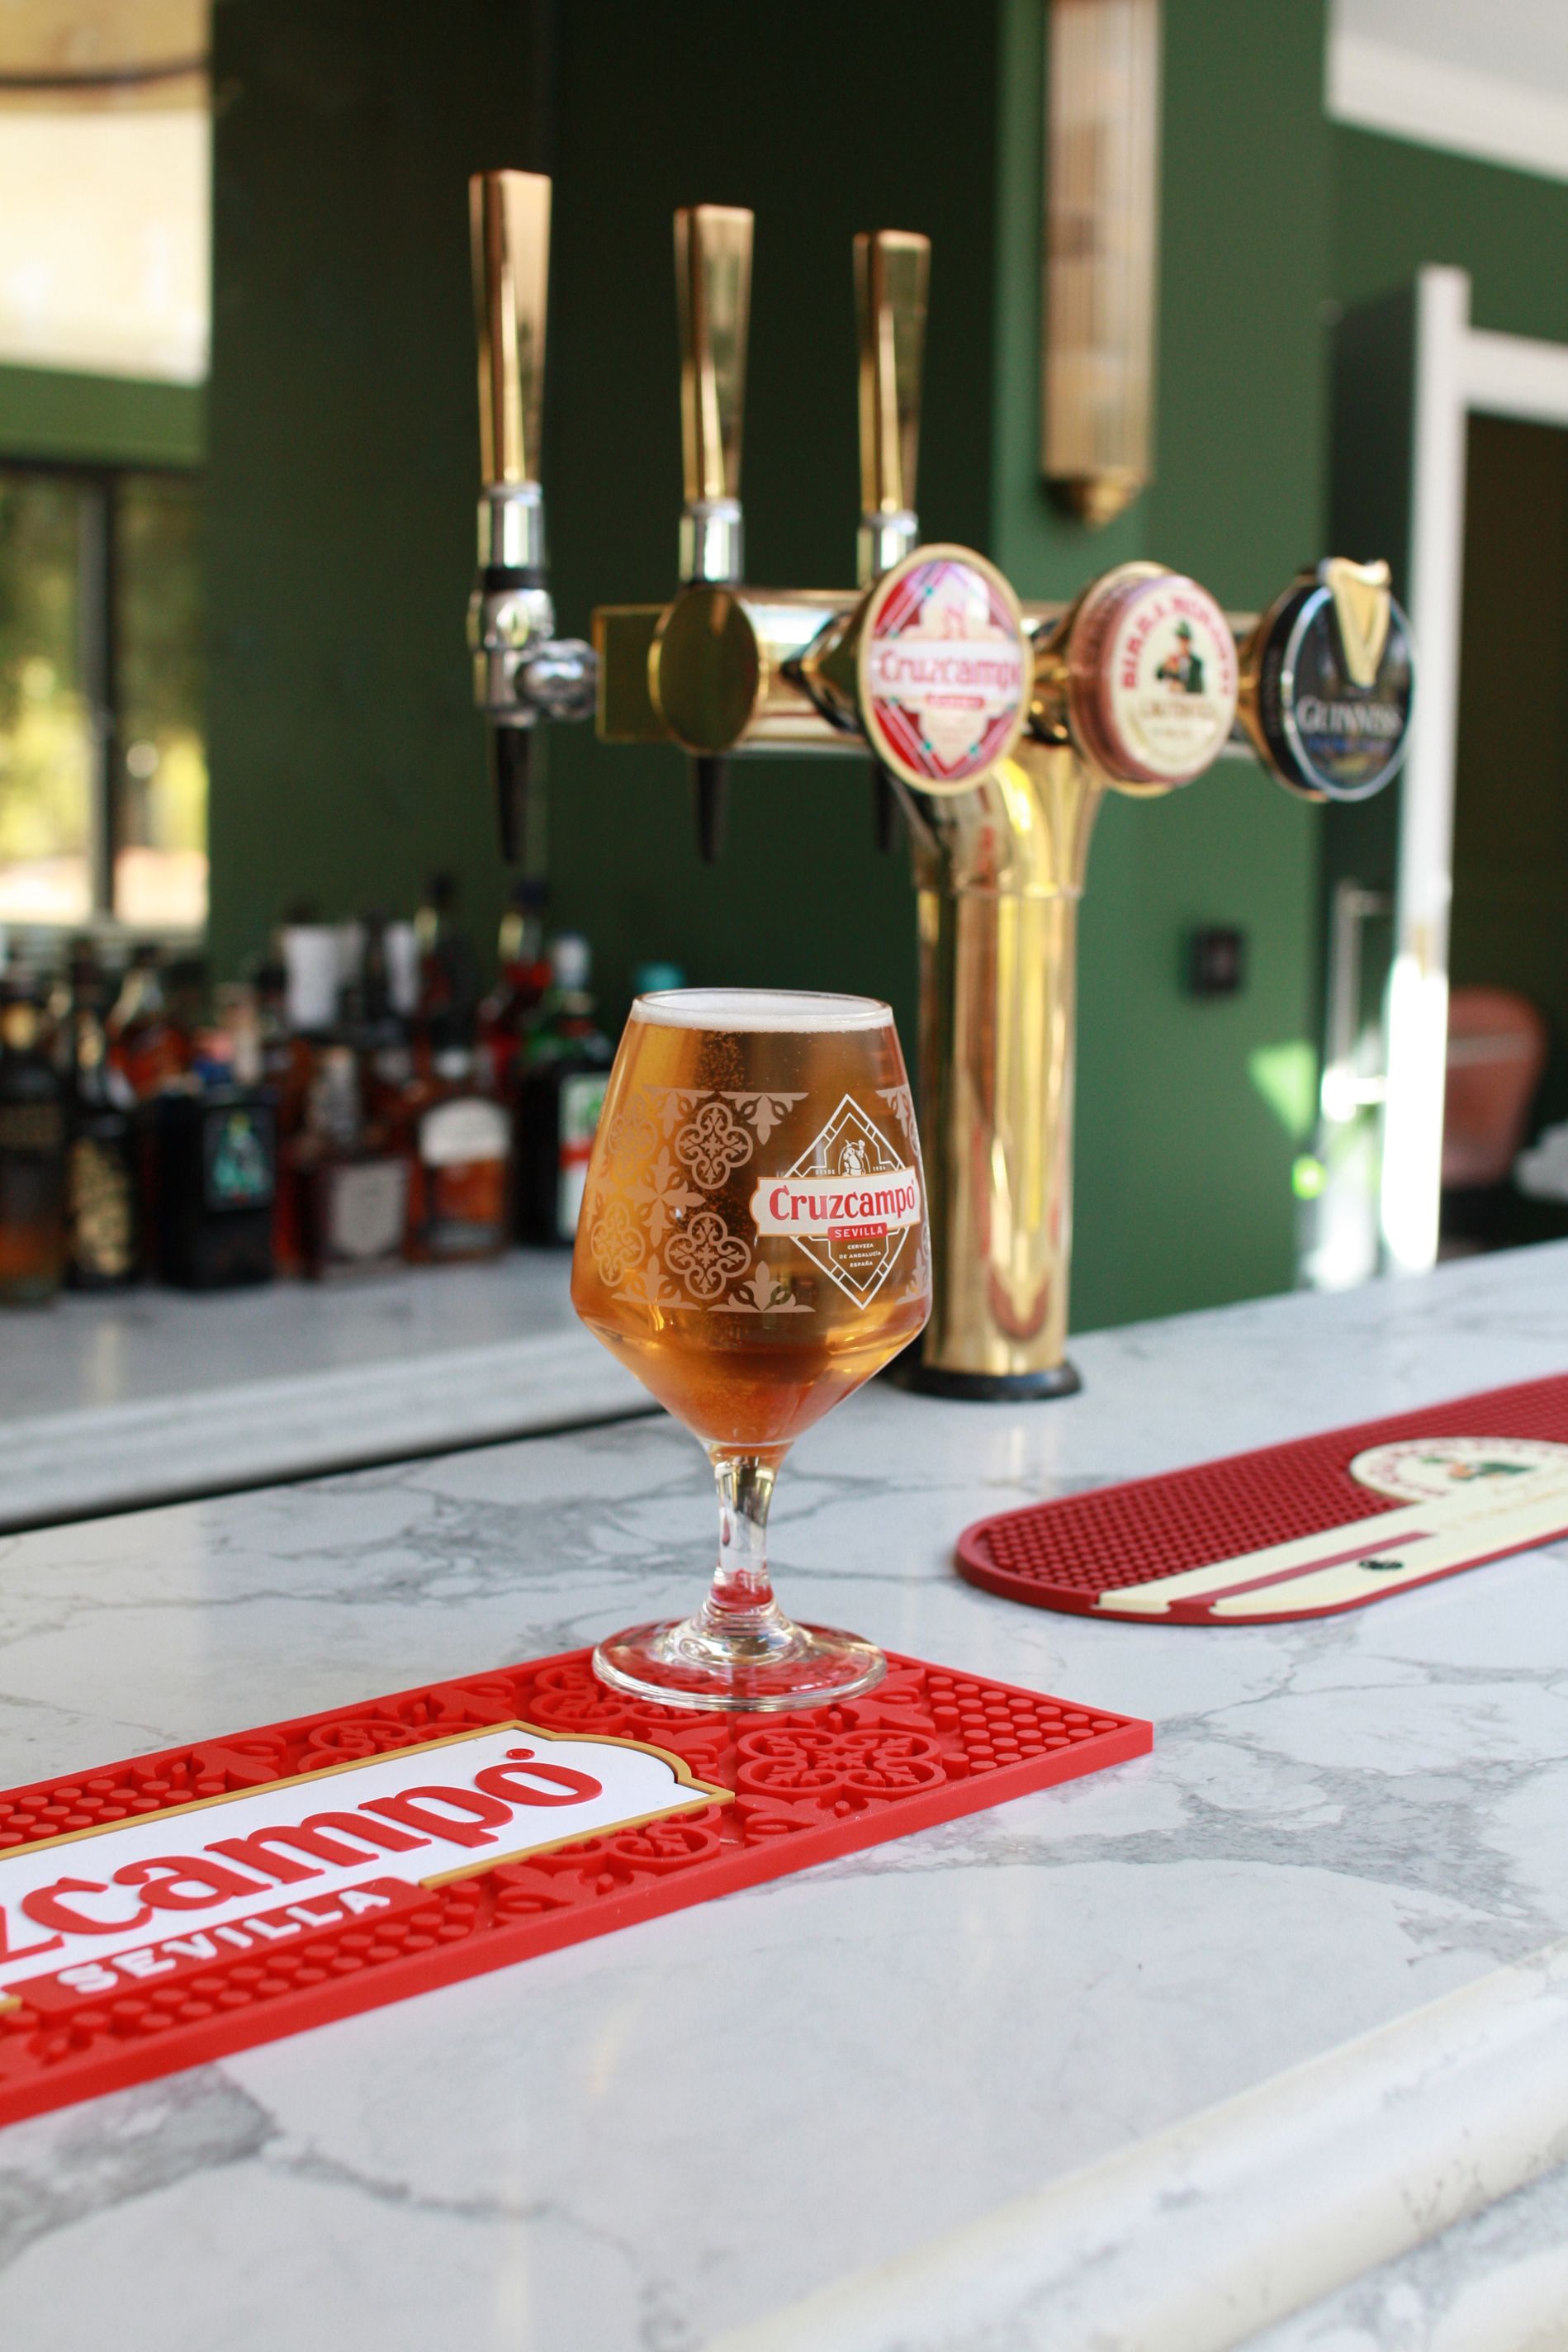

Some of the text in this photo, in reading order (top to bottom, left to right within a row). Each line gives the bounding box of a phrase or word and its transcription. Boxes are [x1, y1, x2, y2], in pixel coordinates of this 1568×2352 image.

[769, 1184, 915, 1221] Cruzcampo
[834, 1226, 883, 1239] SEVILLA
[850, 1260, 874, 1268] ESPAÑA
[57, 1889, 391, 1994] SEVILLA
